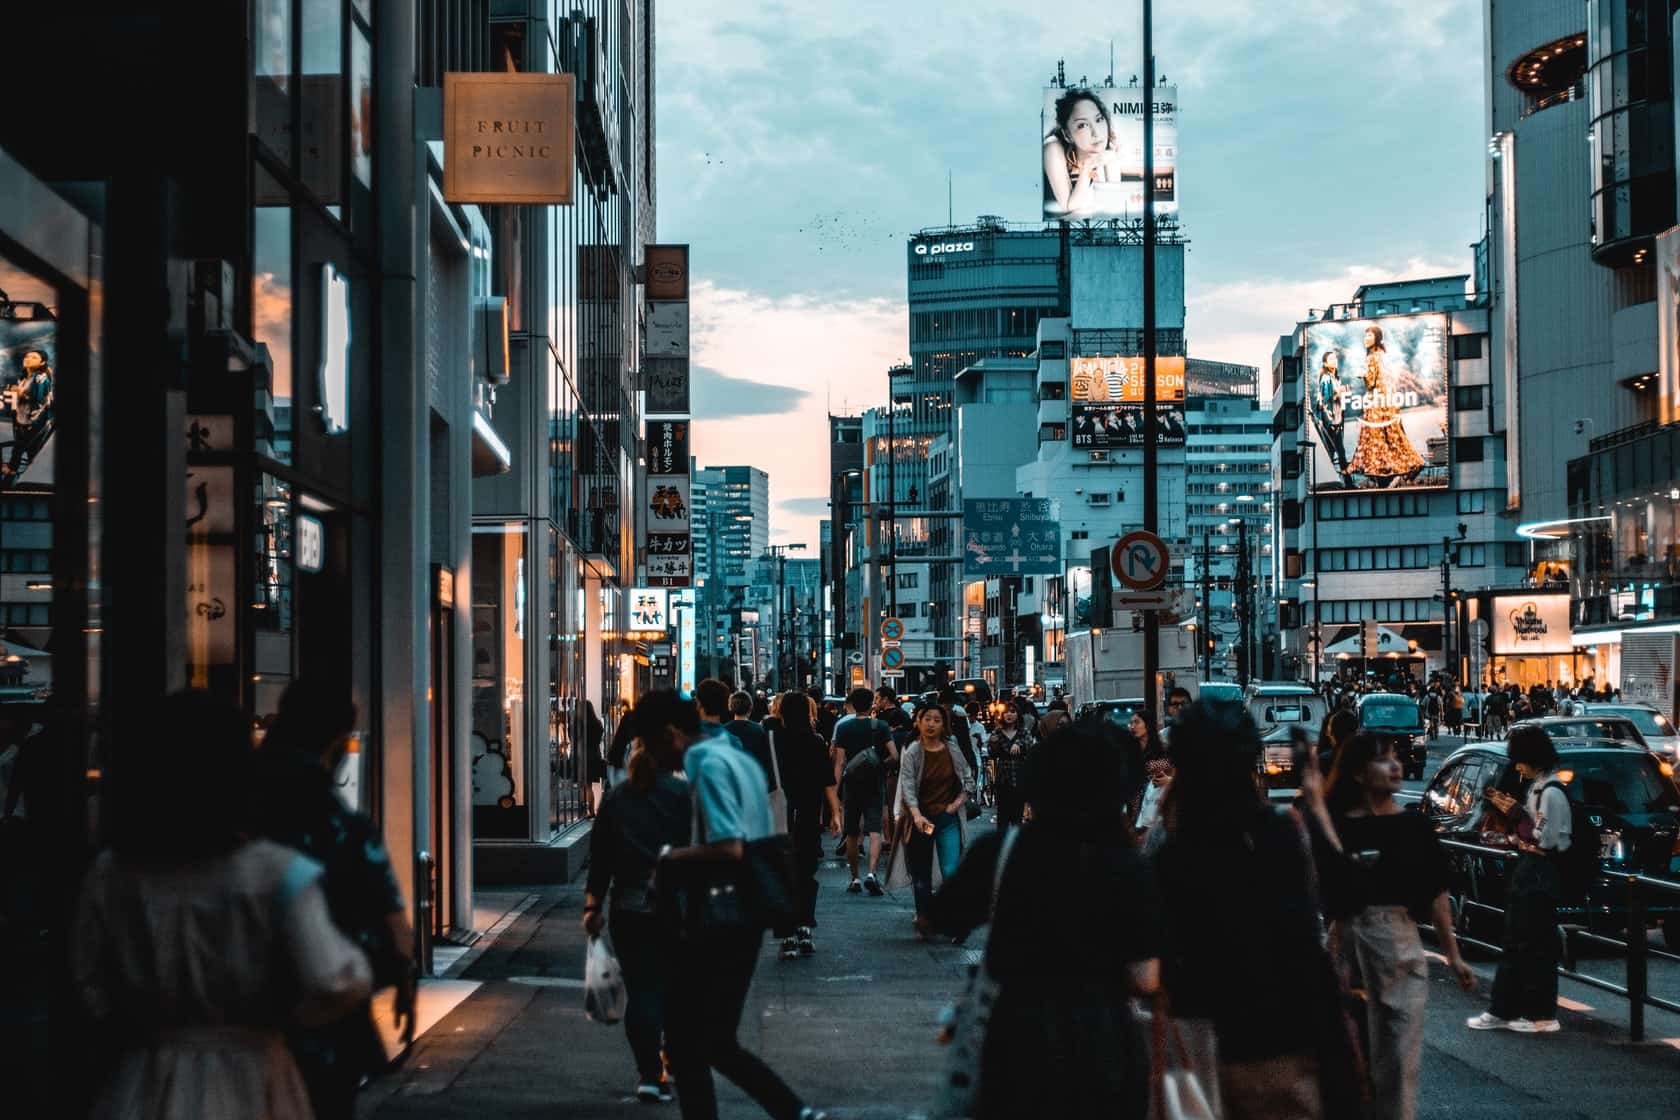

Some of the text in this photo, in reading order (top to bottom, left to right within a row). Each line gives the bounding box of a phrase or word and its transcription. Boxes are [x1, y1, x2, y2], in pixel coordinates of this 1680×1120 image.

[477, 120, 545, 133] FRUIT
[472, 145, 551, 158] PICNIC
[914, 242, 974, 255] Q plaza
[1130, 374, 1184, 387] SESON
[1341, 390, 1419, 411] Fashion
[1075, 434, 1092, 444] BTS
[649, 535, 688, 553] 牛カツ
[1030, 543, 1053, 552] Ohara
[632, 610, 663, 625] てんや
